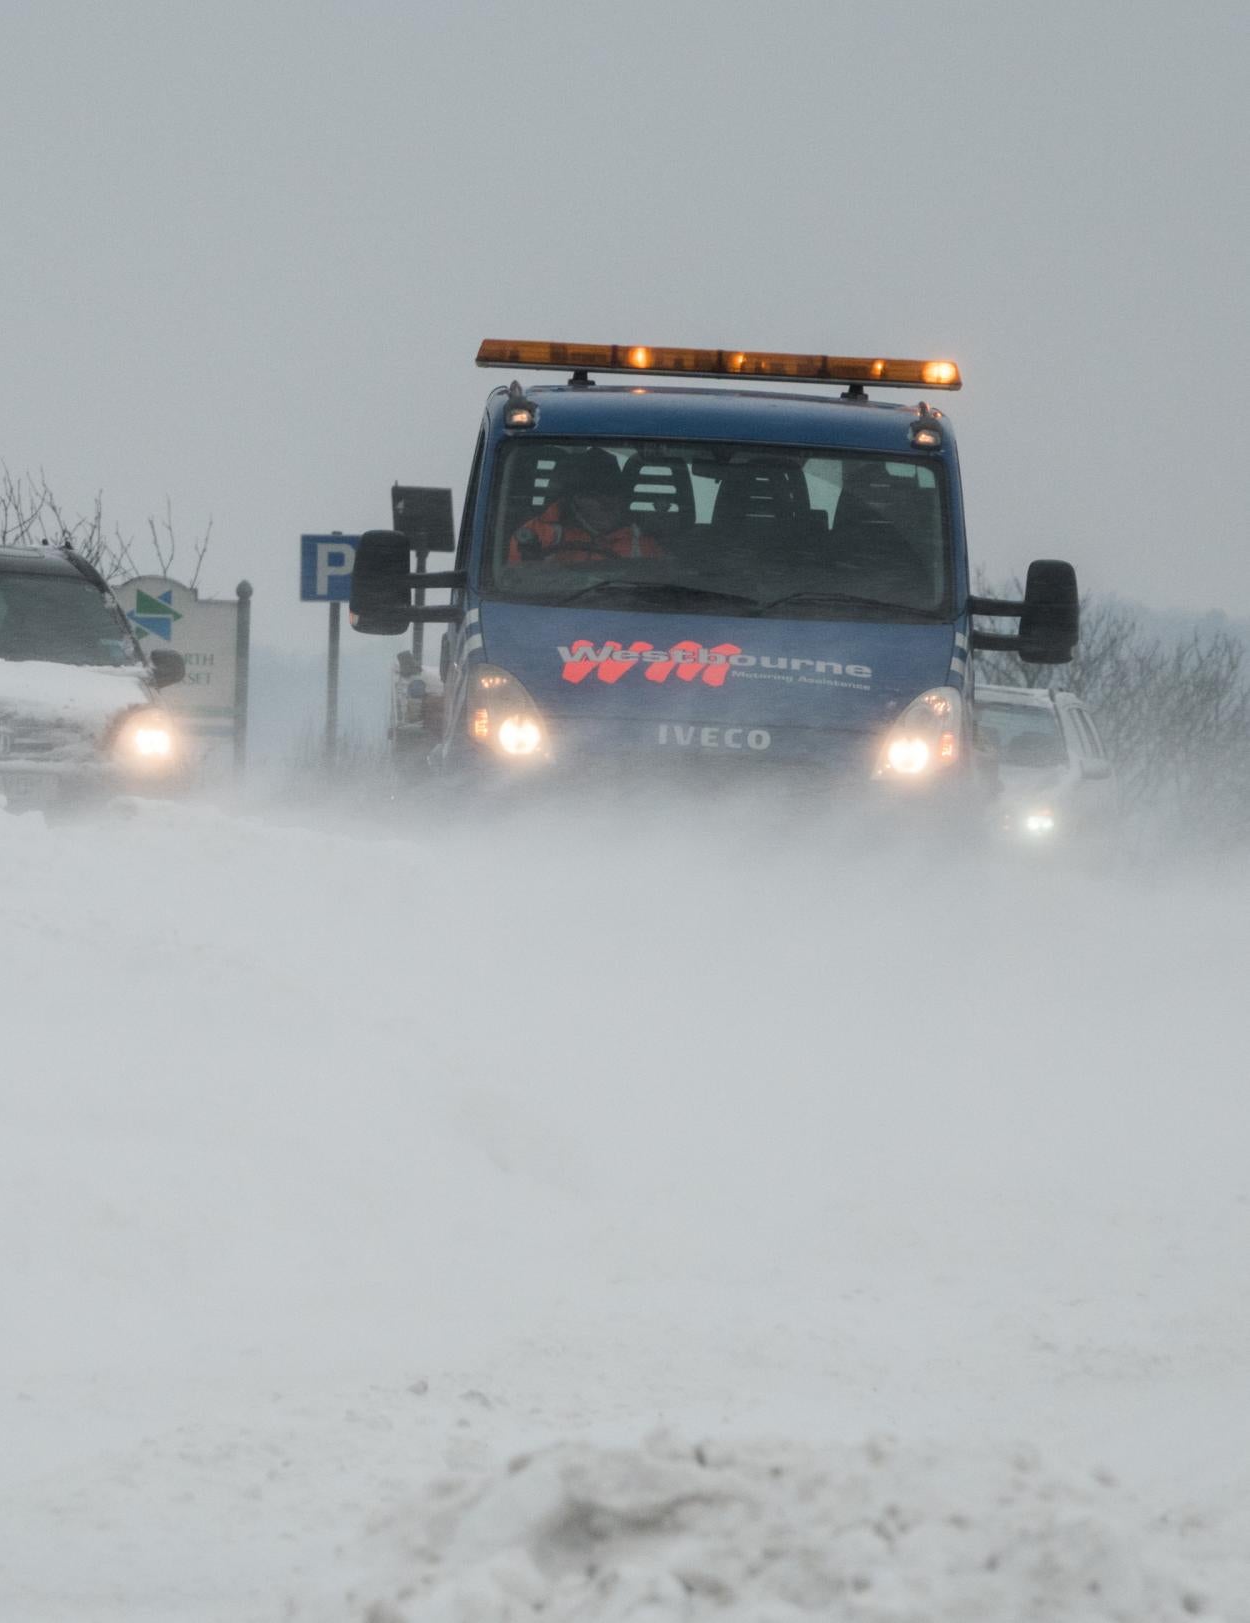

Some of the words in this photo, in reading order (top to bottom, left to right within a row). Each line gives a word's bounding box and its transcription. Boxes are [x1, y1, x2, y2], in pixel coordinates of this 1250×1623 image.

[317, 543, 356, 595] P
[557, 645, 873, 679] Westbourne
[657, 723, 772, 751] IVECO
